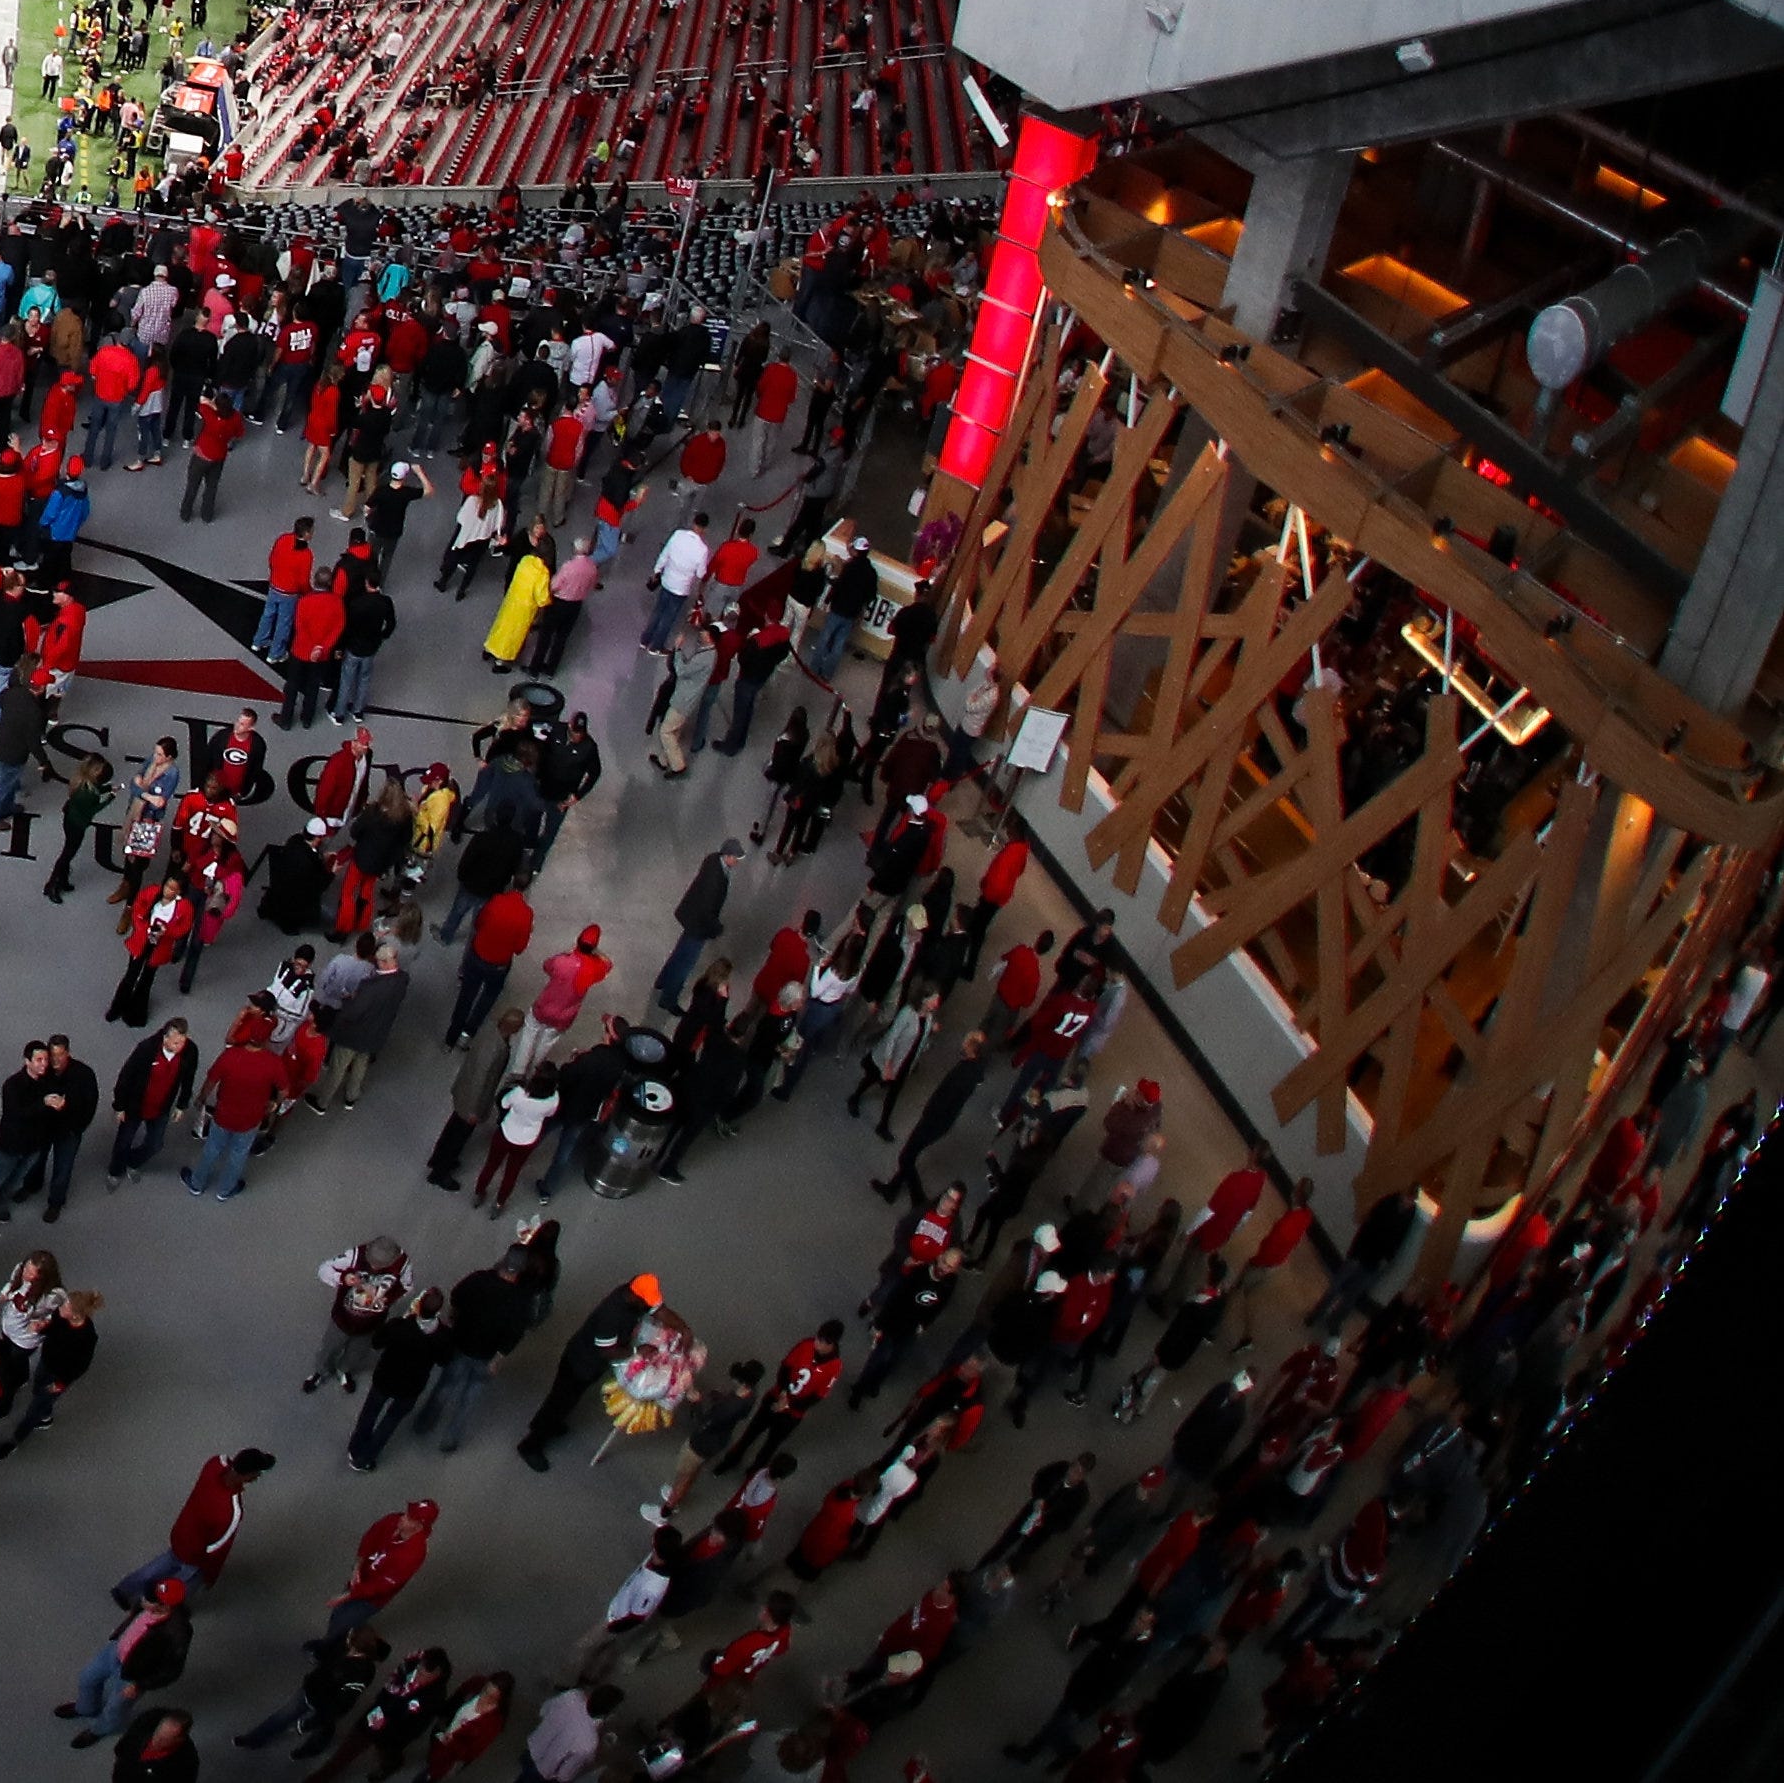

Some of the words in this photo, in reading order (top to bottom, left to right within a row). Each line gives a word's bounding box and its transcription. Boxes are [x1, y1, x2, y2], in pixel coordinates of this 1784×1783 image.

[289, 328, 312, 342] ROLL
[226, 749, 249, 764] G
[188, 810, 222, 839] 47
[789, 1366, 812, 1396] 3
